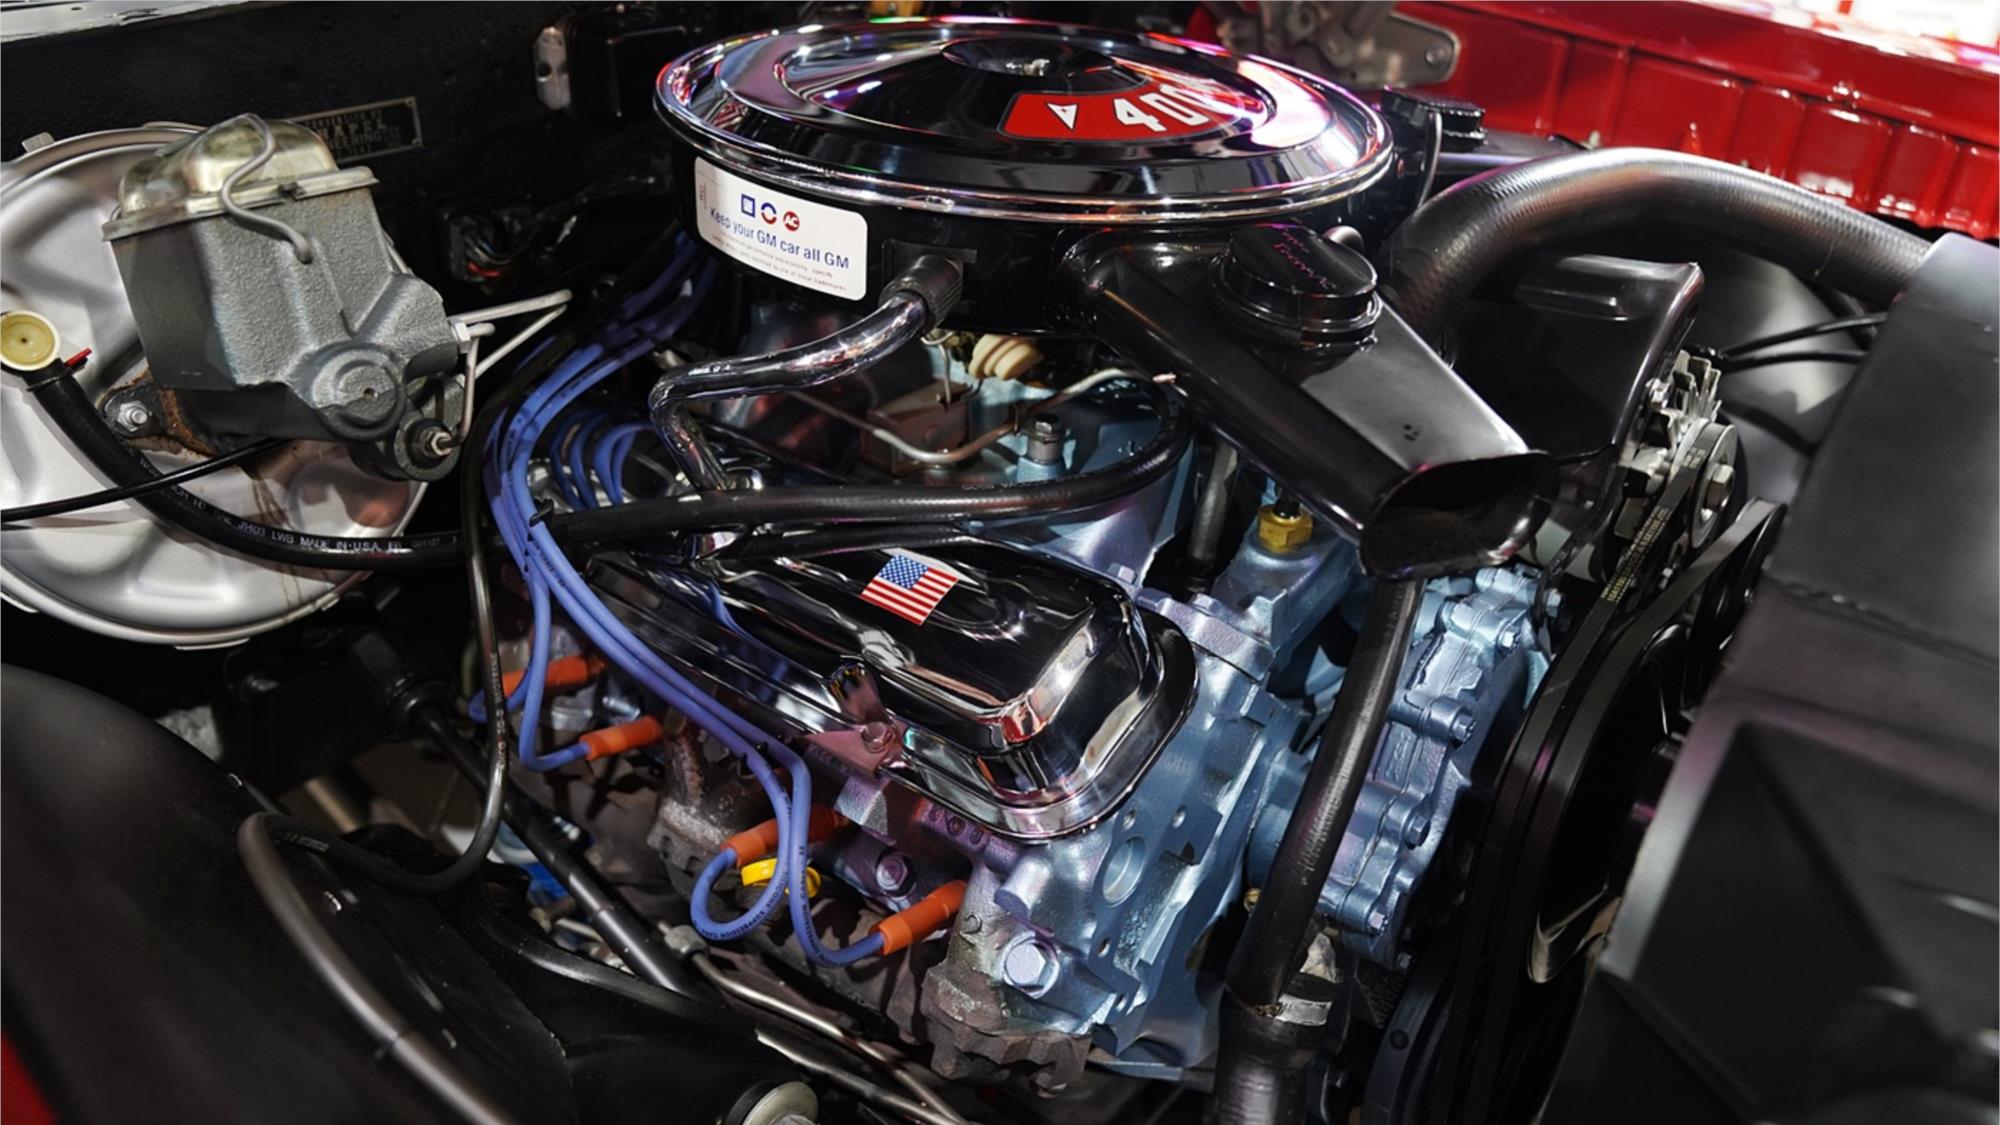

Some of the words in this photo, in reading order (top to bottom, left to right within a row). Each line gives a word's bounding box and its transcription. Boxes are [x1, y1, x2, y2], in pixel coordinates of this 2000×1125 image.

[710, 208, 730, 229] Keep
[733, 221, 754, 239] your
[757, 229, 777, 248] GM
[779, 240, 800, 255] car
[803, 247, 820, 262] all
[824, 251, 849, 269] GM
[300, 536, 329, 551] MADE
